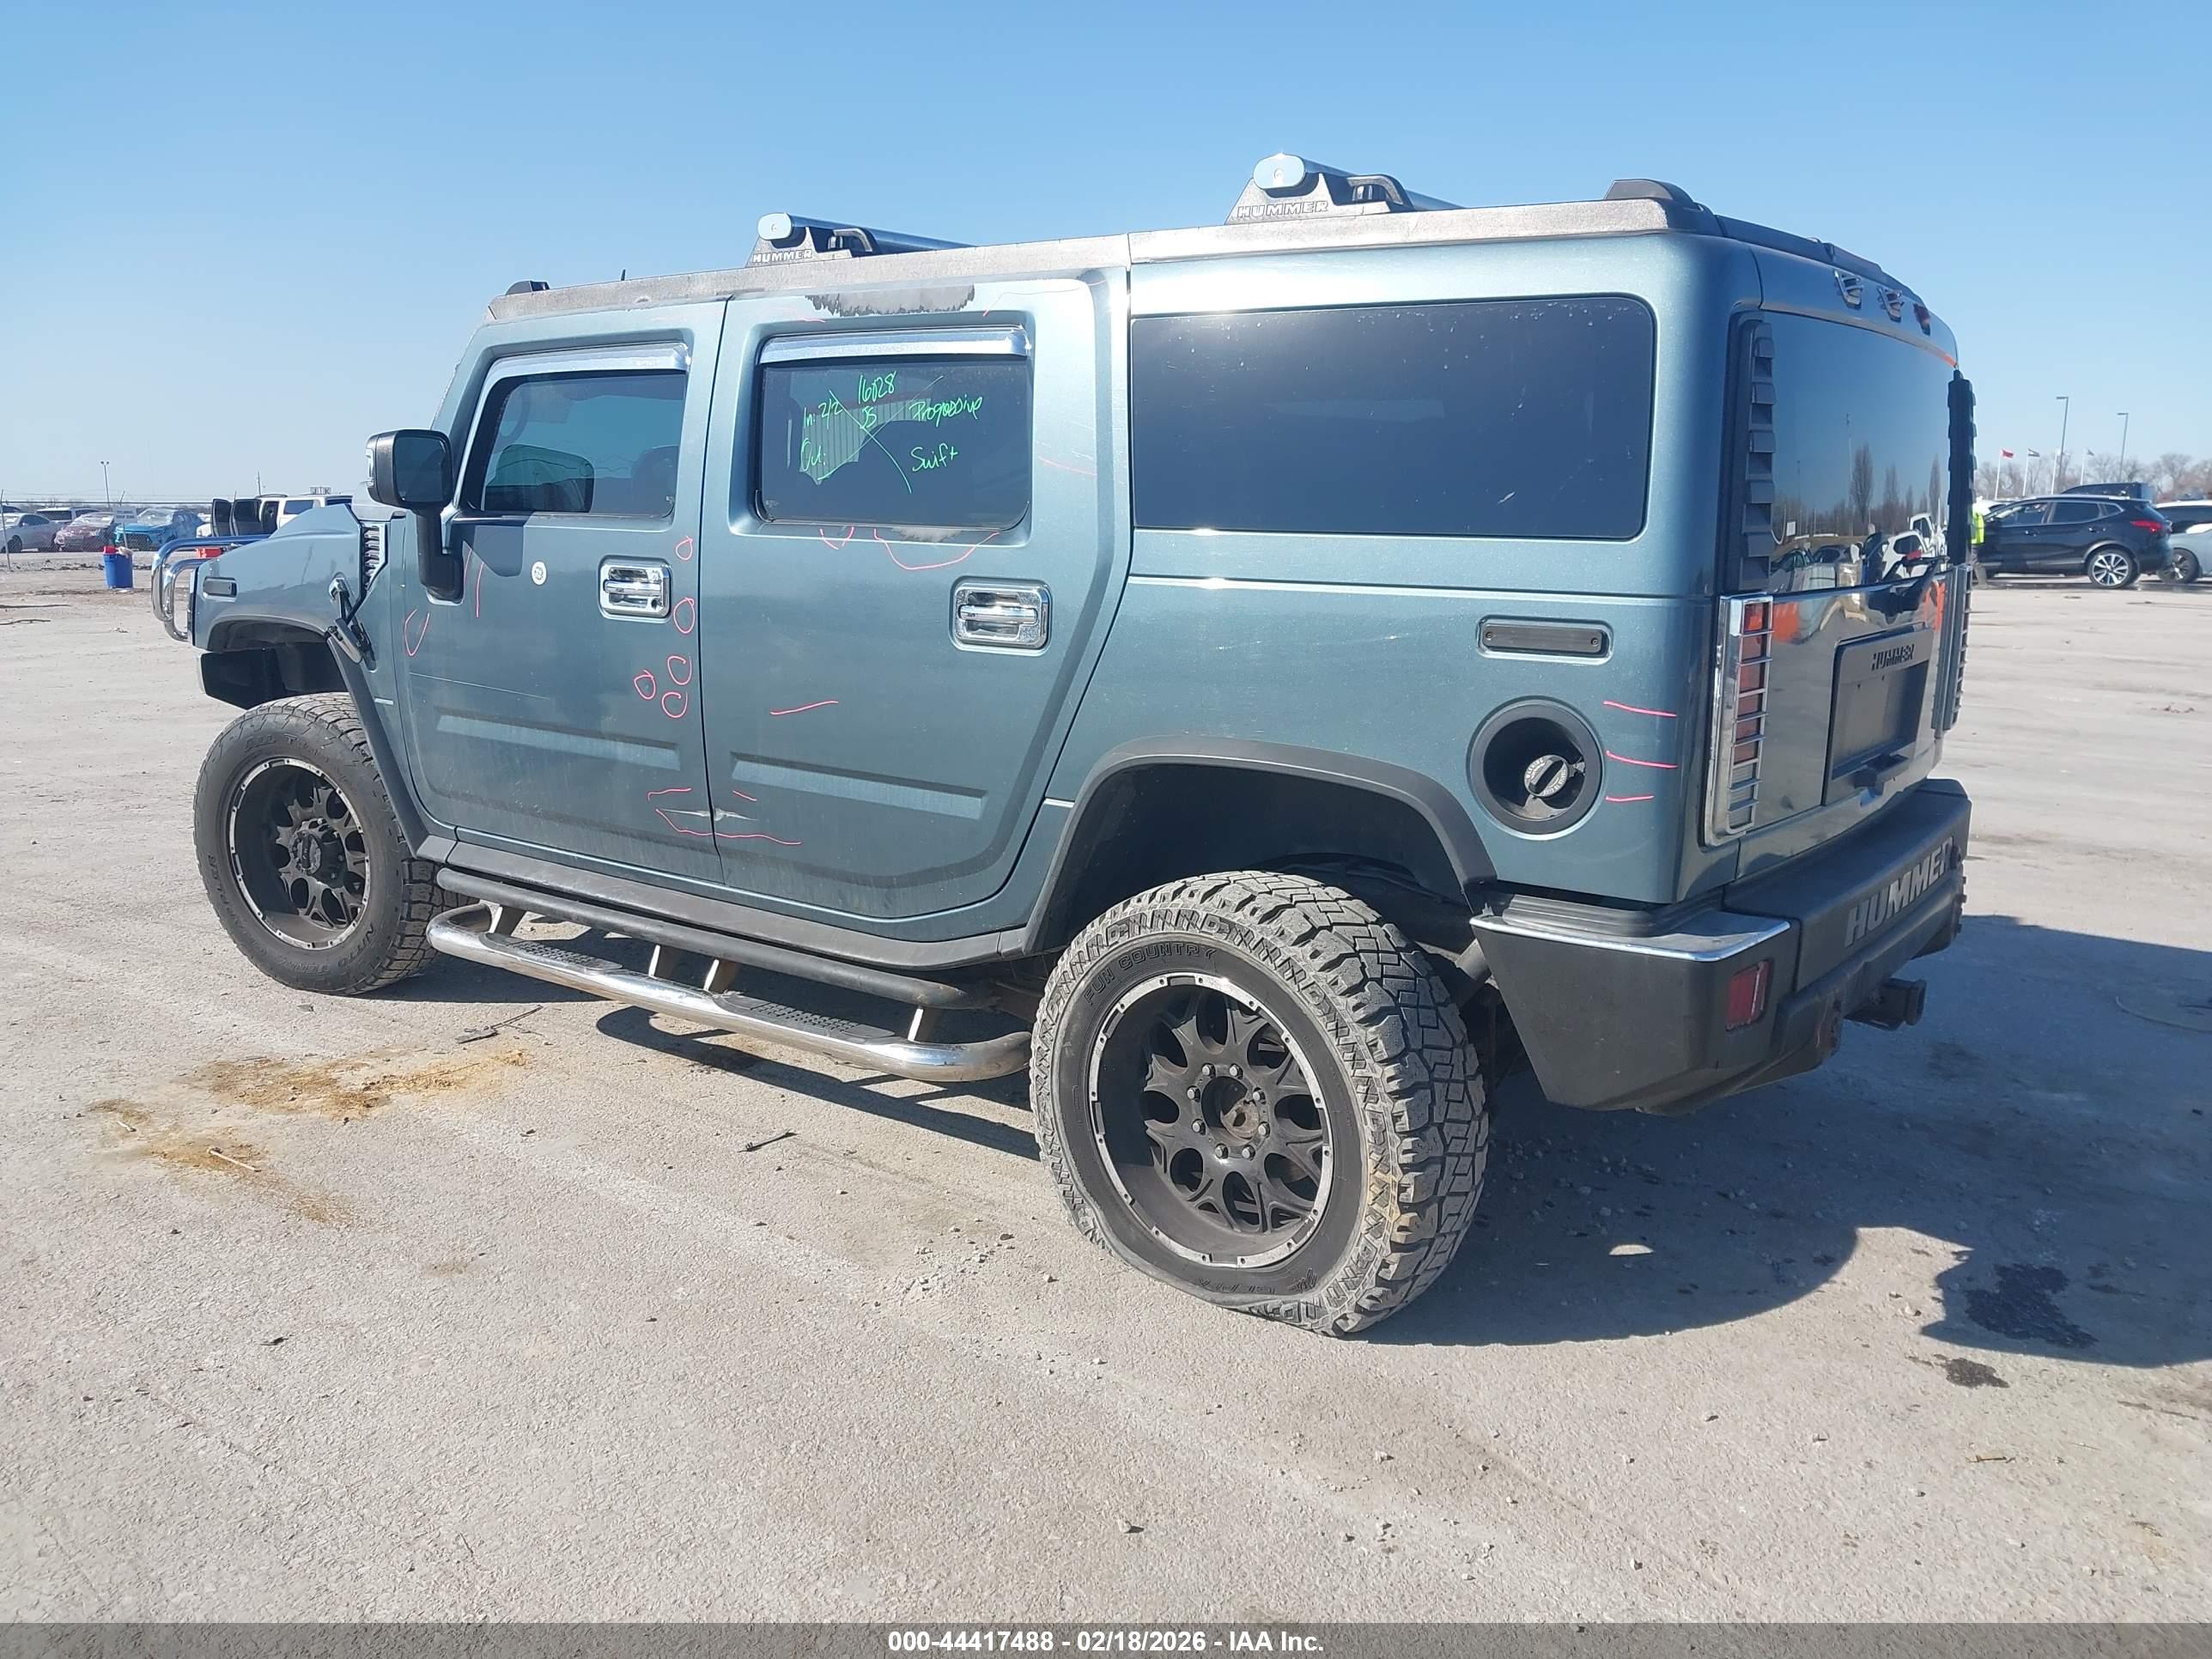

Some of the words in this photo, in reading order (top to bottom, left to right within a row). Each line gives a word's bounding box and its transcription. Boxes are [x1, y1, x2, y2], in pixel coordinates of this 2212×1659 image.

[1237, 200, 1328, 218] HUMMER
[752, 249, 812, 263] HUMMER
[858, 371, 897, 404] 16028
[1871, 644, 1915, 672] HUMMER
[1845, 836, 1956, 948] HUMMER
[1083, 965, 1115, 1005] FUN
[1119, 943, 1217, 971] COUNTRY
